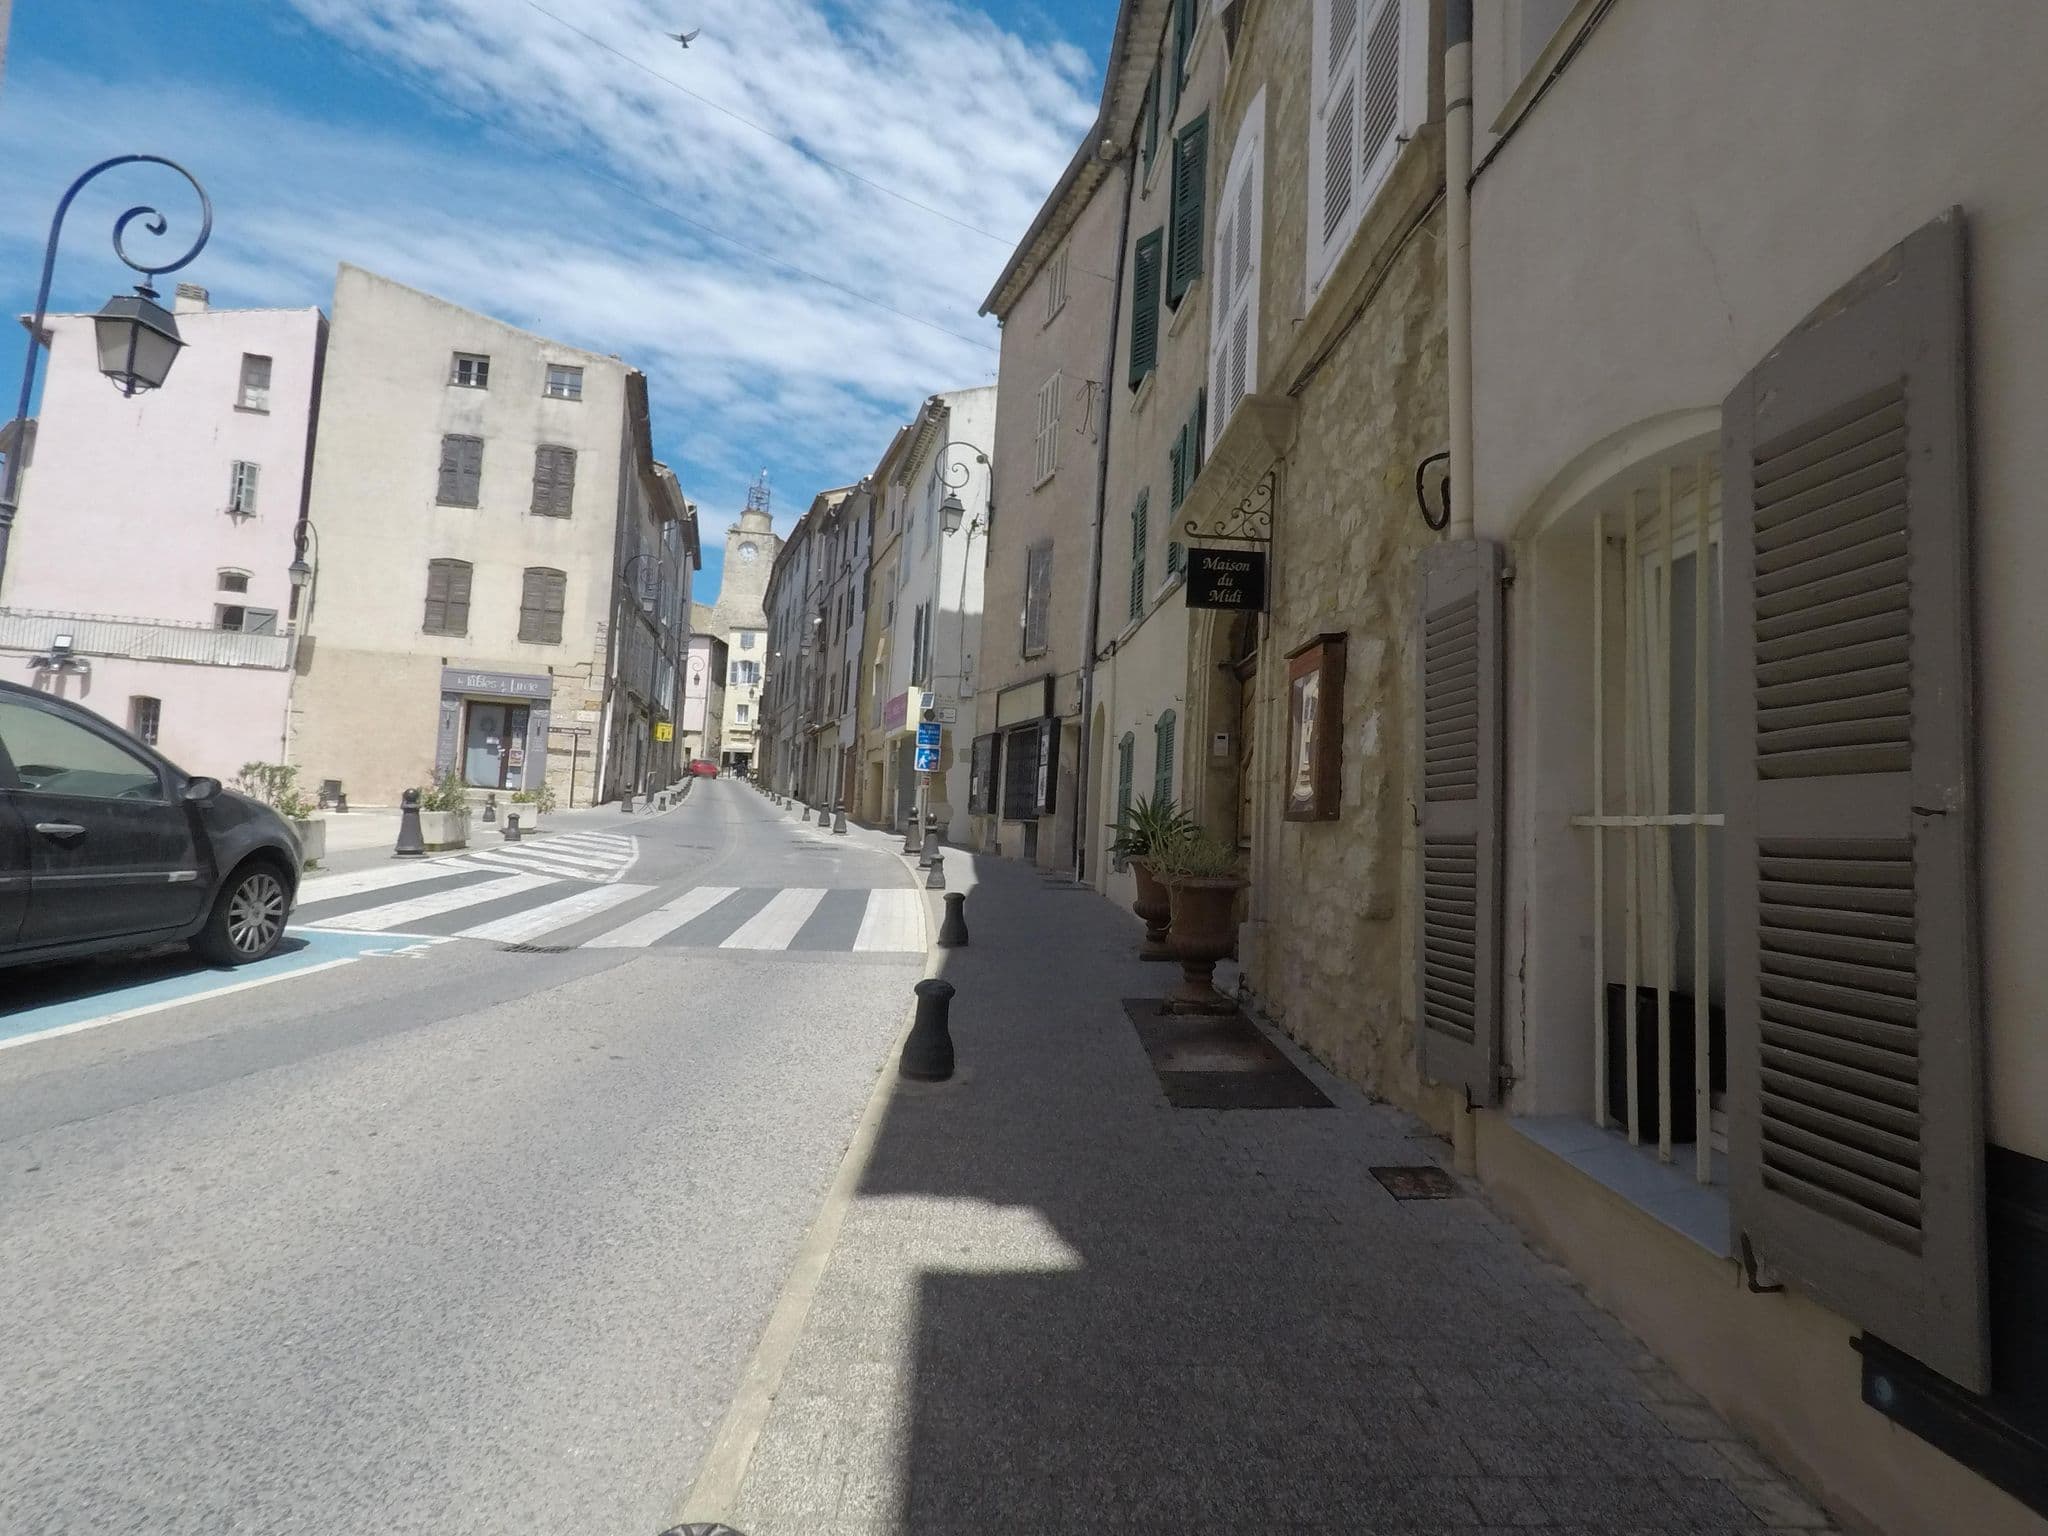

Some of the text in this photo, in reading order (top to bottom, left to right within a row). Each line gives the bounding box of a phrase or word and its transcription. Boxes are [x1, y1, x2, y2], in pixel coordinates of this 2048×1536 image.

[1203, 557, 1250, 572] Maison
[1217, 573, 1233, 586] du
[1208, 589, 1242, 603] Midi
